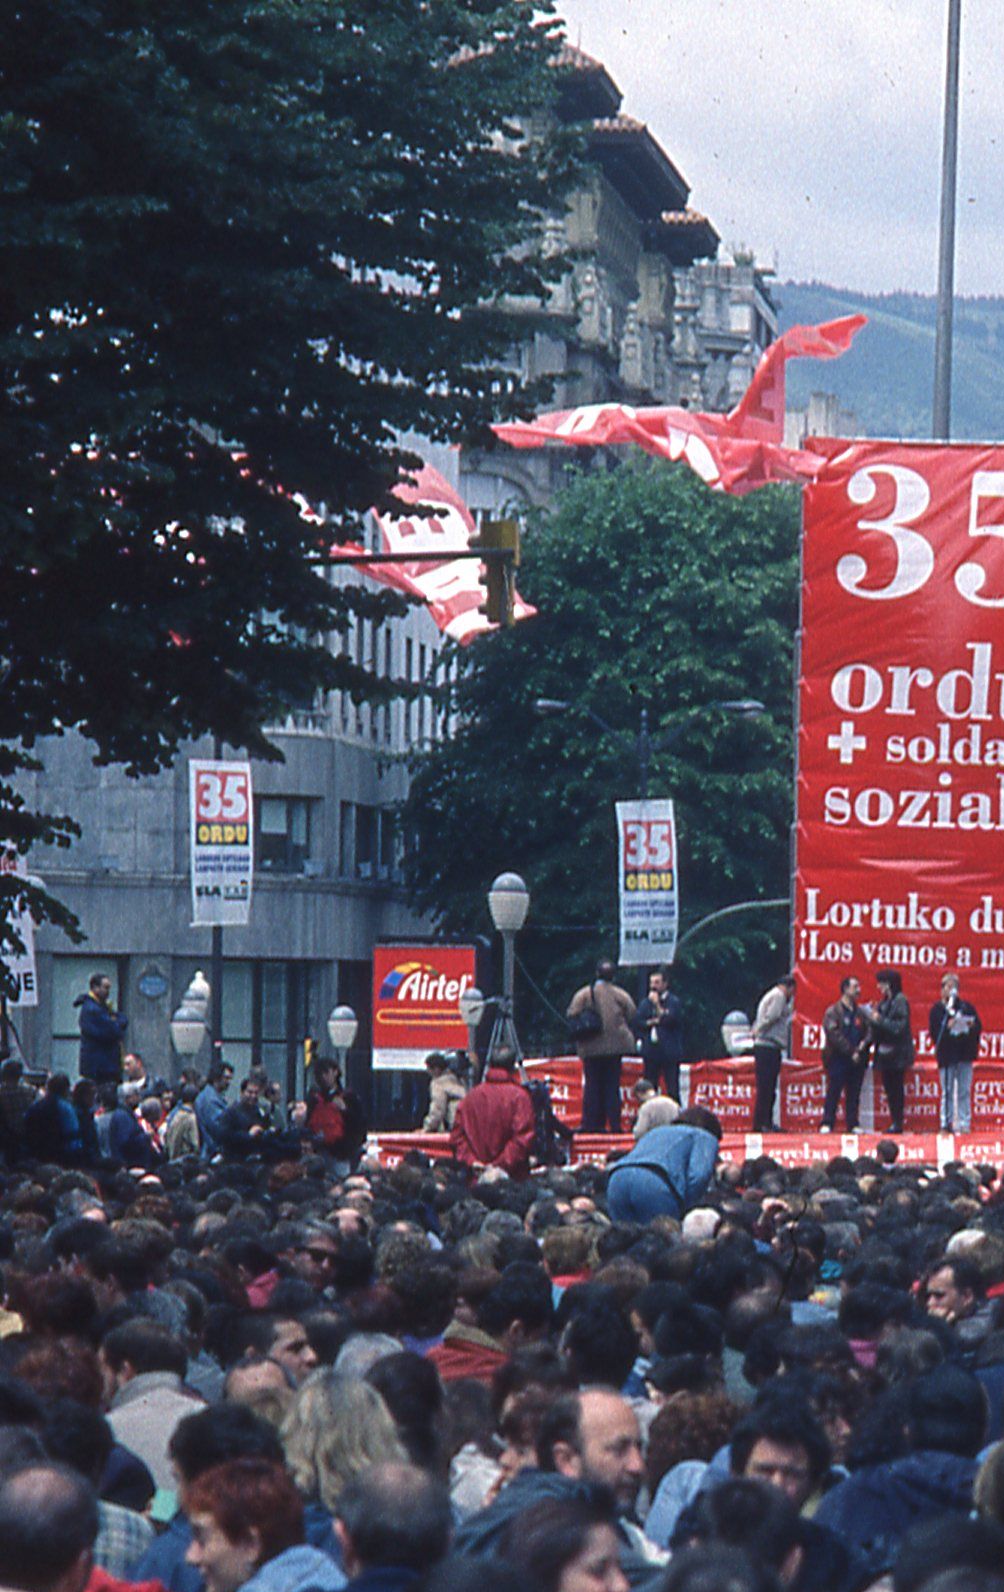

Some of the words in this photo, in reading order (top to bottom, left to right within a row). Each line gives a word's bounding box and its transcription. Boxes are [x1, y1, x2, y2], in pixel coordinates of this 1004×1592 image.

[199, 773, 247, 818] 35
[198, 824, 248, 845] ORDU
[626, 824, 671, 866] 35
[625, 872, 673, 890] ORDU
[804, 888, 955, 932] Lortuko
[800, 930, 853, 962] ¡Los
[862, 943, 947, 967] vamos
[957, 946, 971, 967] a
[398, 971, 467, 1001] Airtel
[695, 1074, 752, 1104] greba
